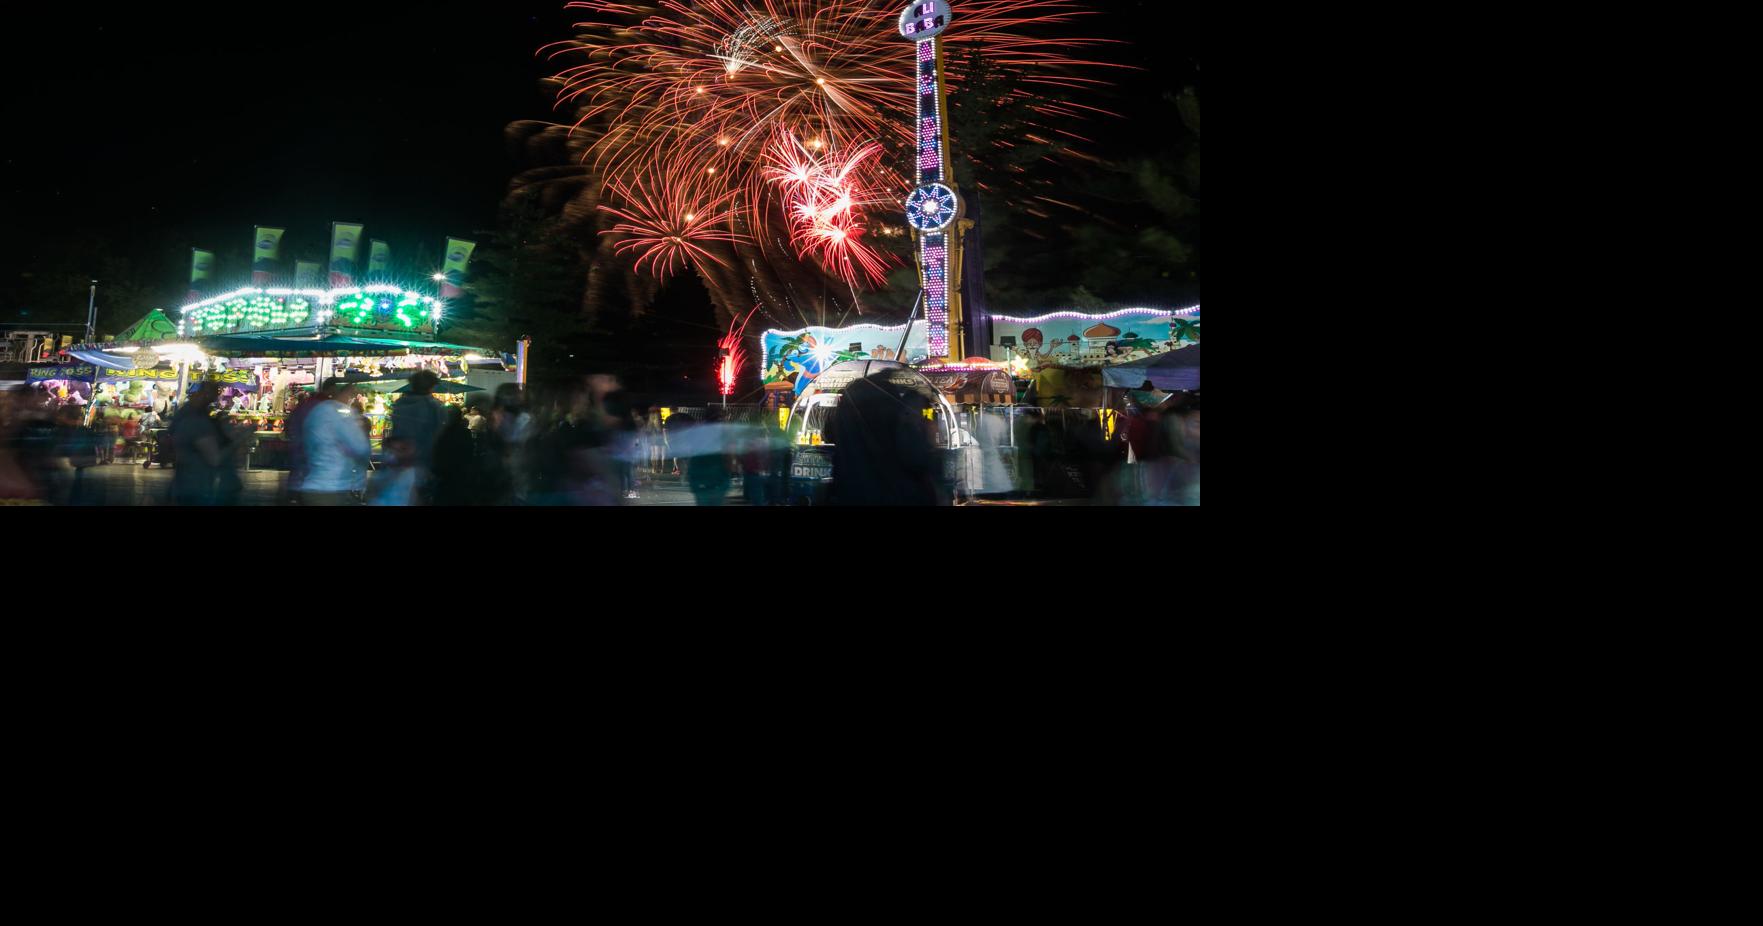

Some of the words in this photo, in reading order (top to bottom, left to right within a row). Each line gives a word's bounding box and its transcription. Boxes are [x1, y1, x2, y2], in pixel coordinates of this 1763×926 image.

[914, 2, 934, 18] ALI
[905, 15, 944, 34] BABA
[31, 368, 56, 377] RING
[106, 368, 179, 379] RING
